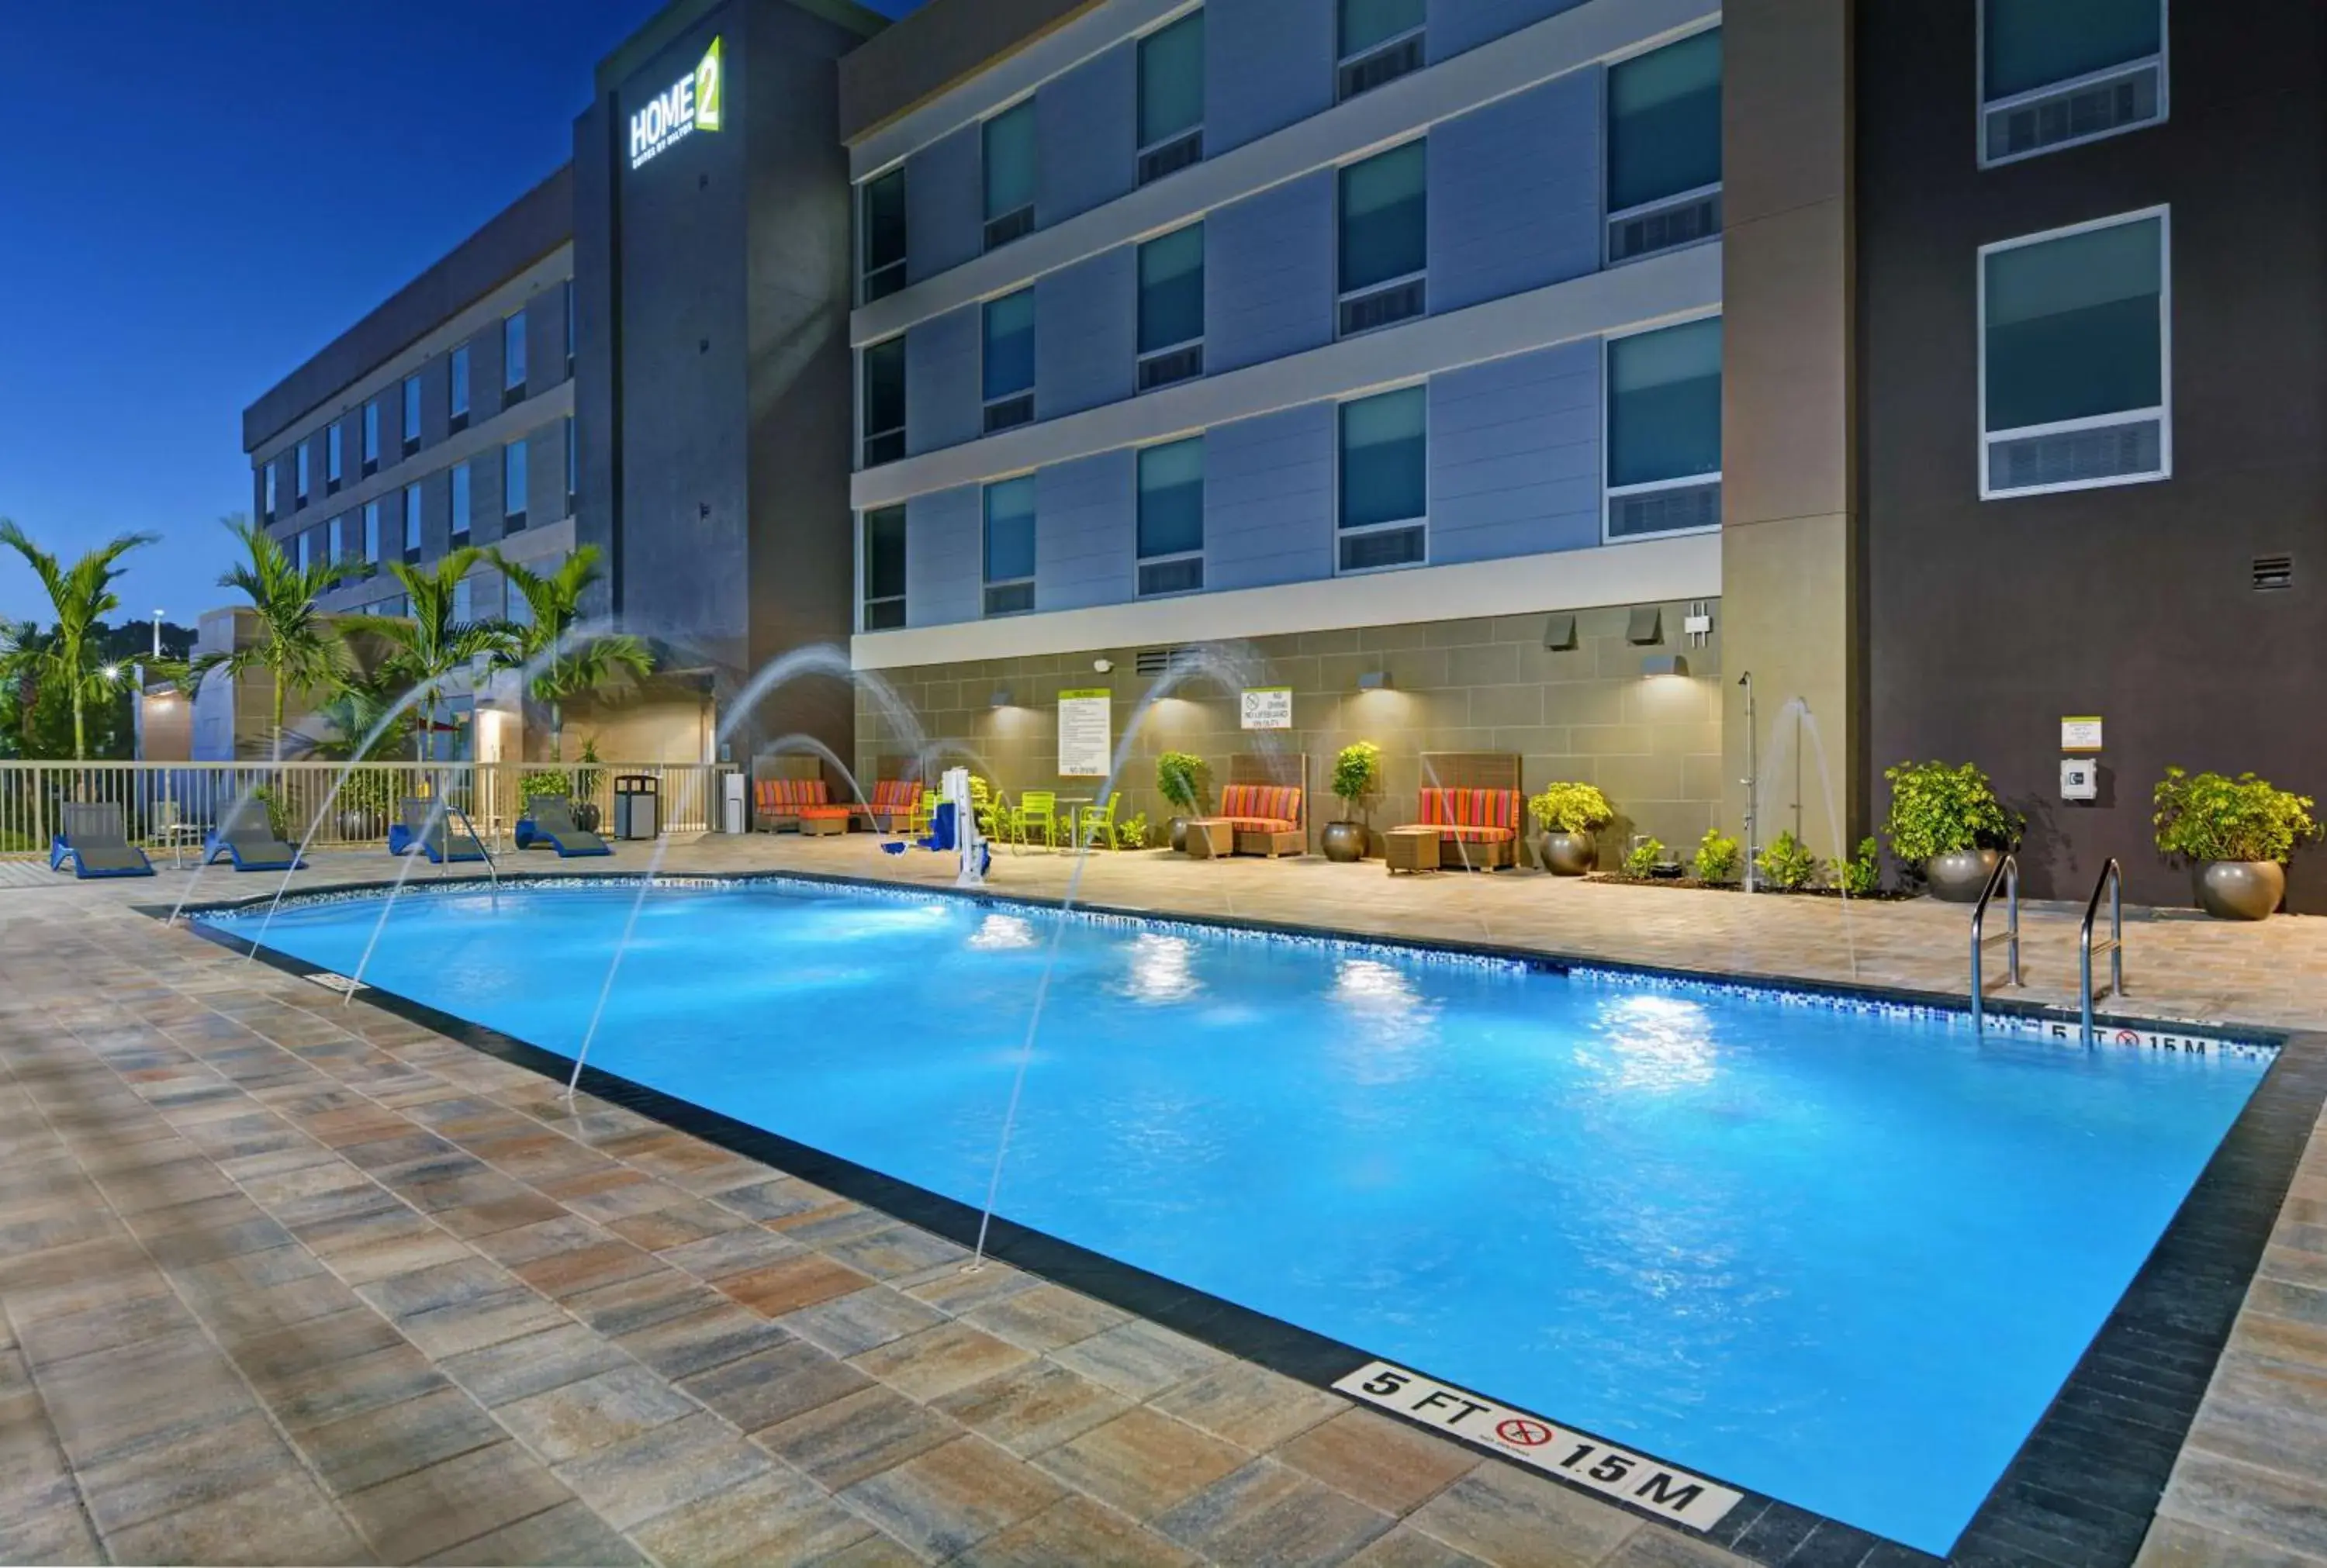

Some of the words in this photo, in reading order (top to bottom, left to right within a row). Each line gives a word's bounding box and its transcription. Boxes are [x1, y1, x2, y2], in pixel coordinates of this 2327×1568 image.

[631, 71, 694, 157] HOME
[2184, 1039, 2206, 1055] M
[1362, 1370, 1411, 1395] 5
[1410, 1390, 1492, 1425] FT
[1634, 1472, 1705, 1512] M
